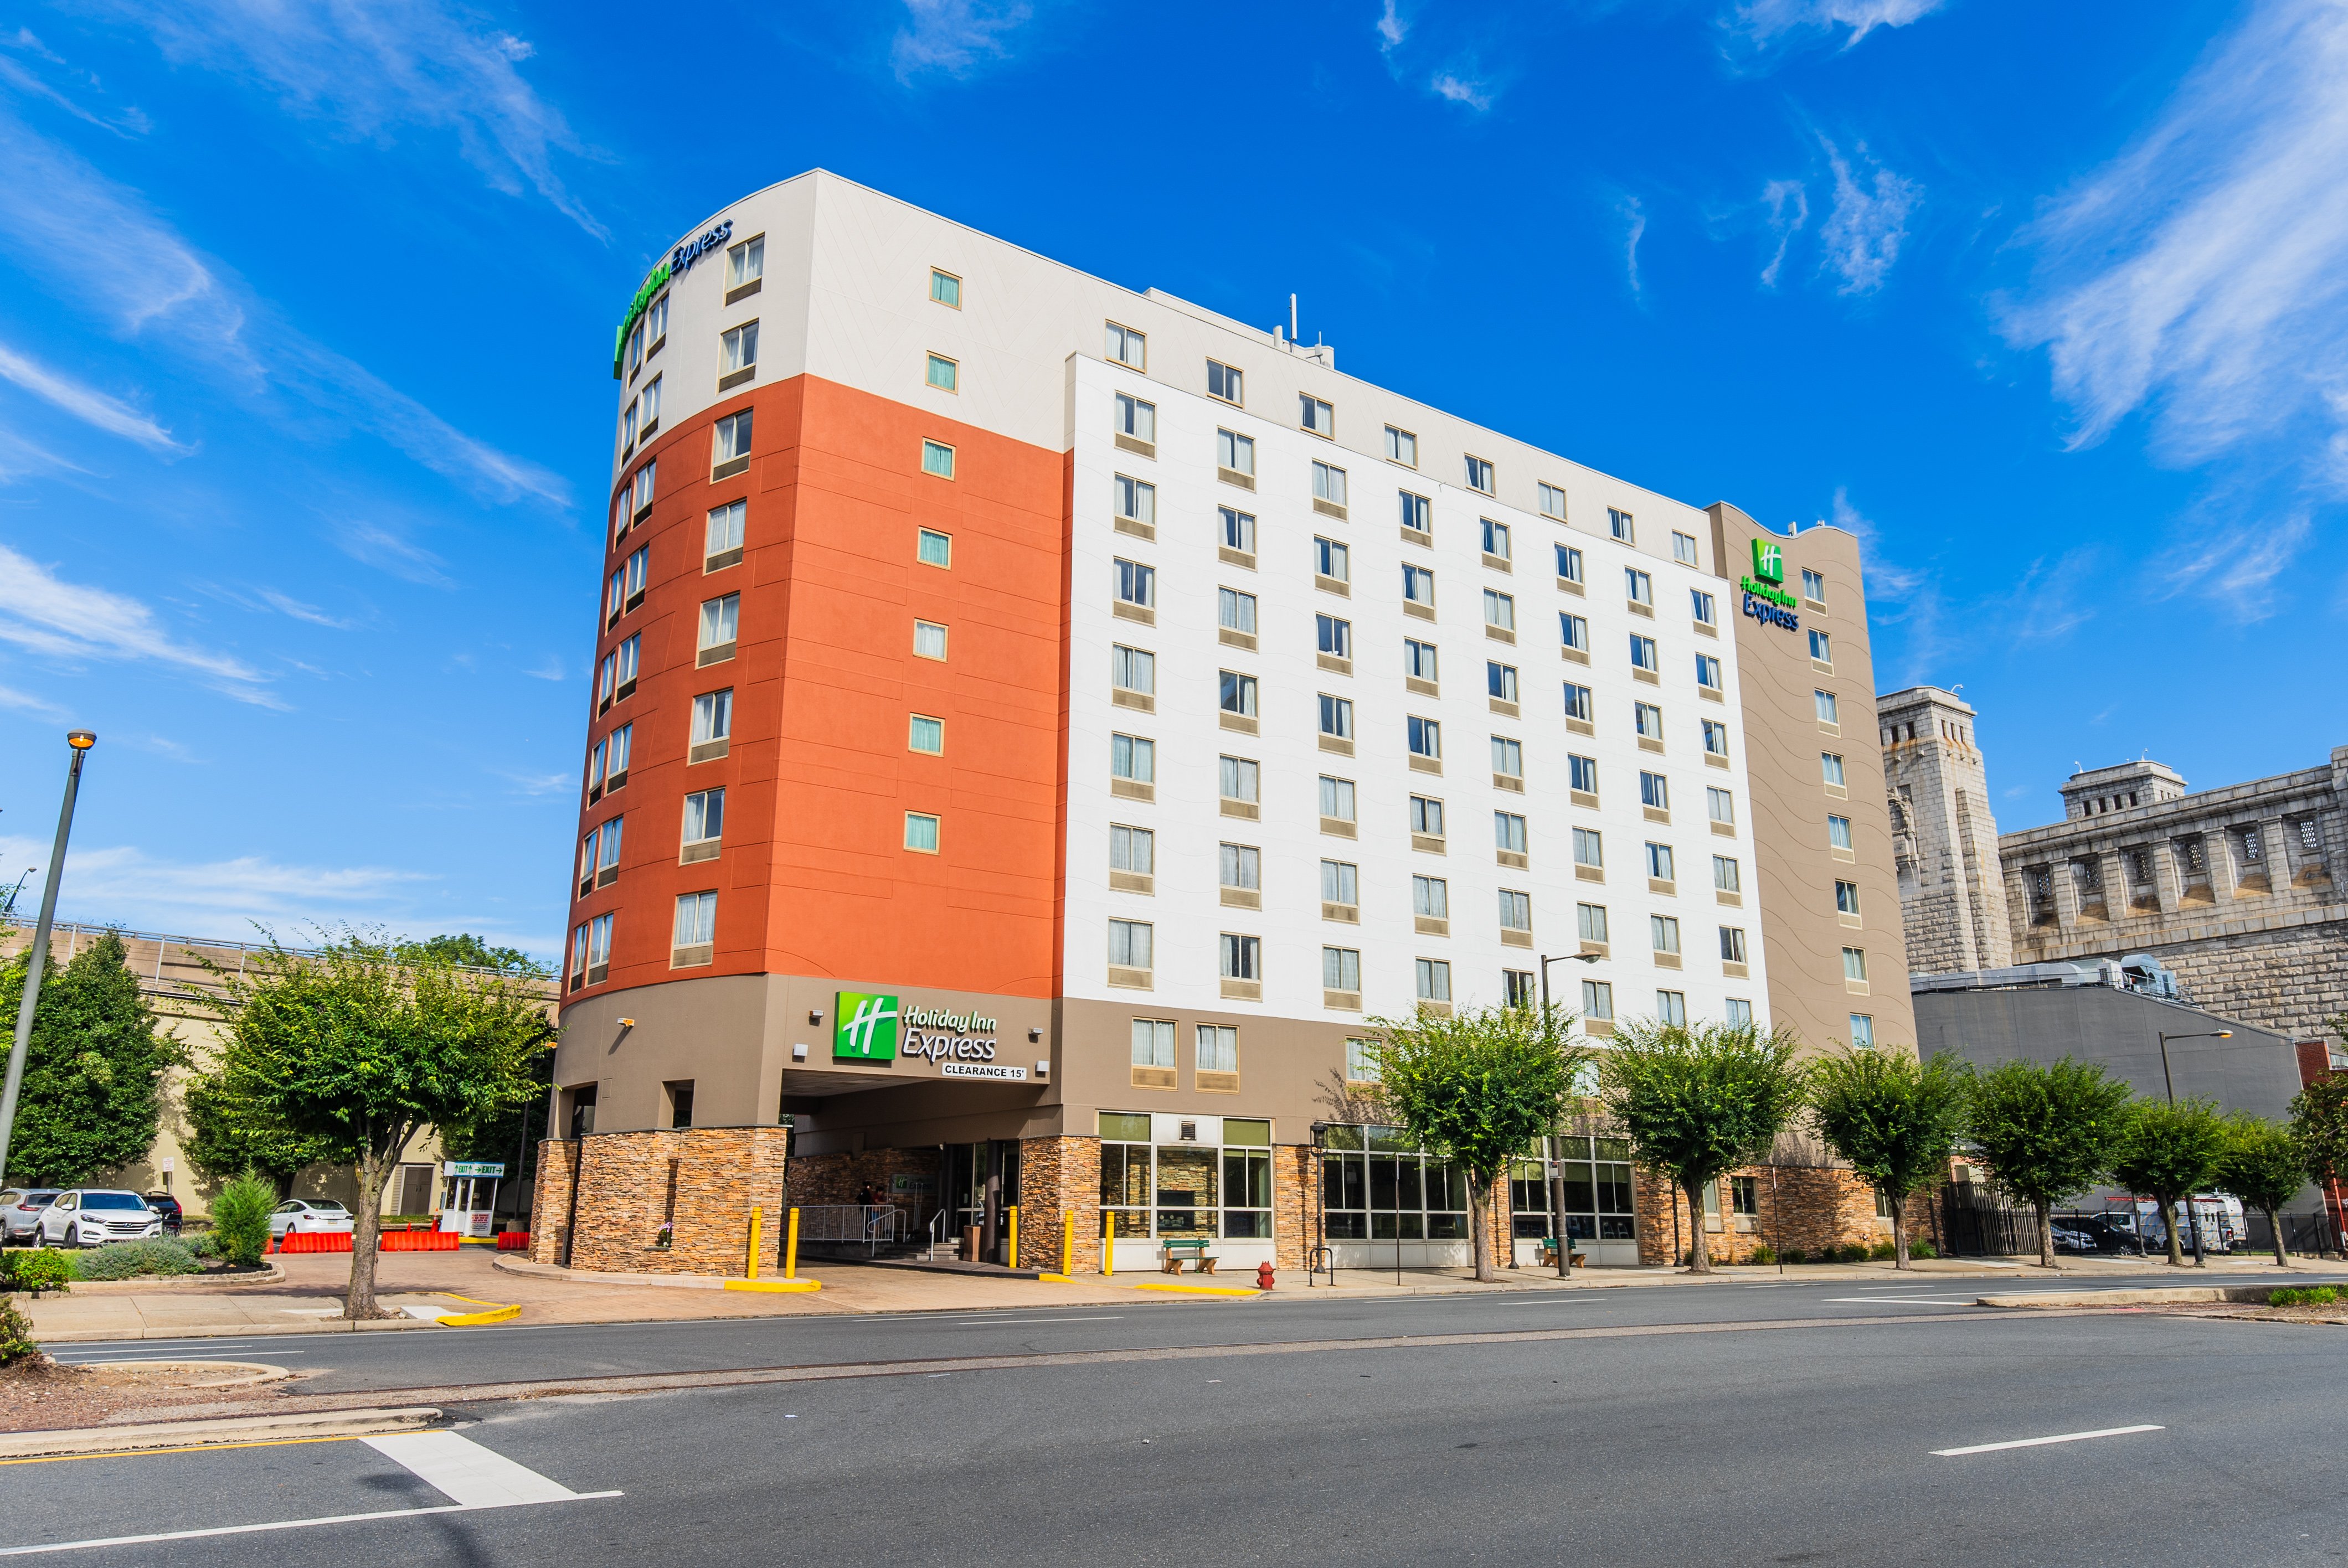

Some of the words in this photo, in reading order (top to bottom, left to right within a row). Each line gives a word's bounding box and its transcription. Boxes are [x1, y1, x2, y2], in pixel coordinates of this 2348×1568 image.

[670, 219, 734, 275] Express
[1741, 575, 1781, 605] Holiday
[1780, 589, 1798, 607] Inn
[1743, 593, 1799, 630] Express
[903, 1005, 969, 1033] Holiday
[970, 1010, 997, 1030] Inn
[903, 1028, 996, 1062] Express
[945, 1065, 1007, 1077] CLEARANCE
[1010, 1069, 1024, 1077] 15'
[482, 1165, 496, 1174] EXIT
